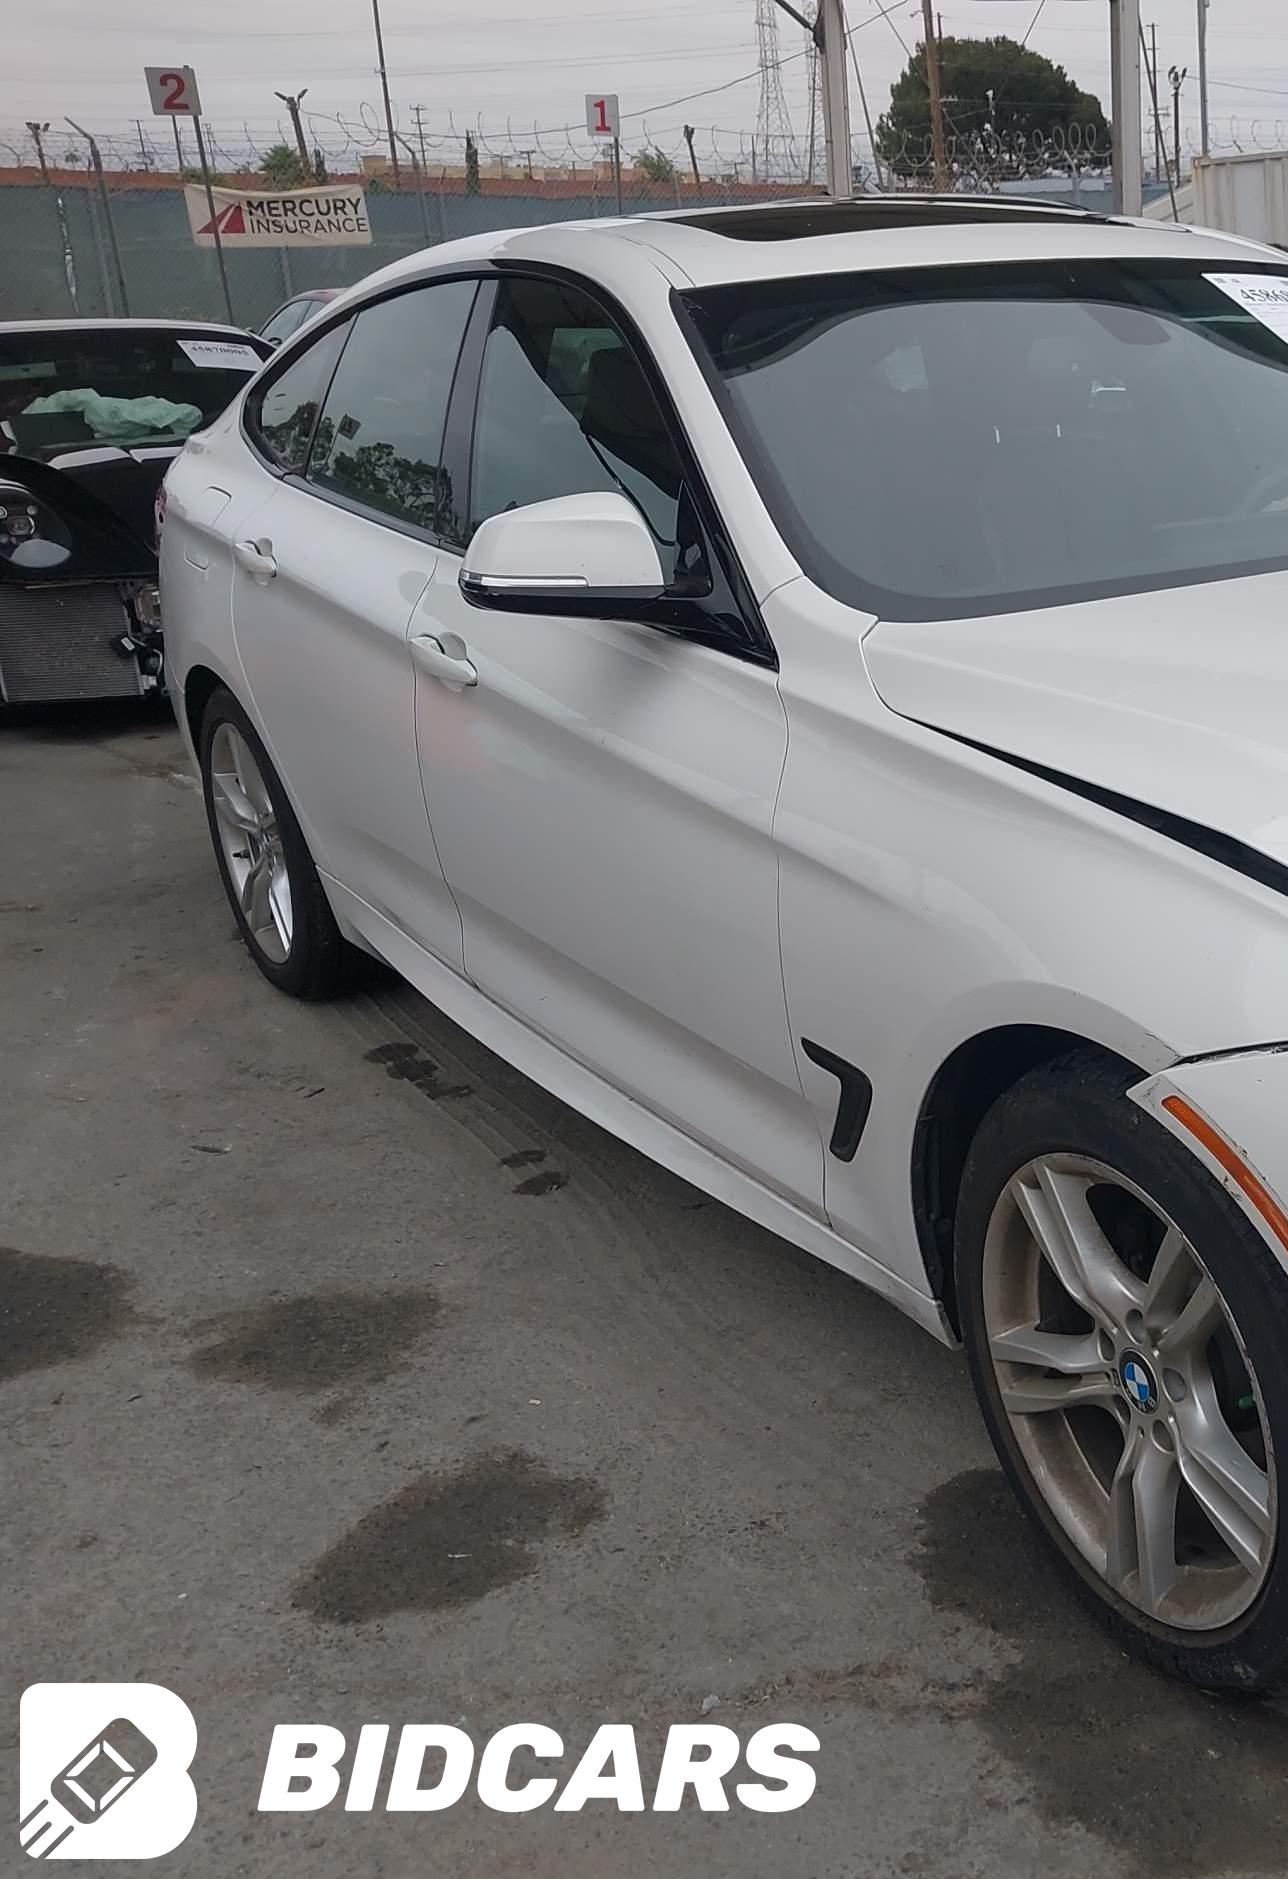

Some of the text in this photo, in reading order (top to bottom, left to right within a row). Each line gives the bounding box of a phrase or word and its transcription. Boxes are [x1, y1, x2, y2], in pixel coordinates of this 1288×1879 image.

[159, 73, 190, 110] 2
[593, 100, 612, 132] 1
[246, 198, 361, 217] MERCURY
[250, 218, 369, 234] INSURANCE
